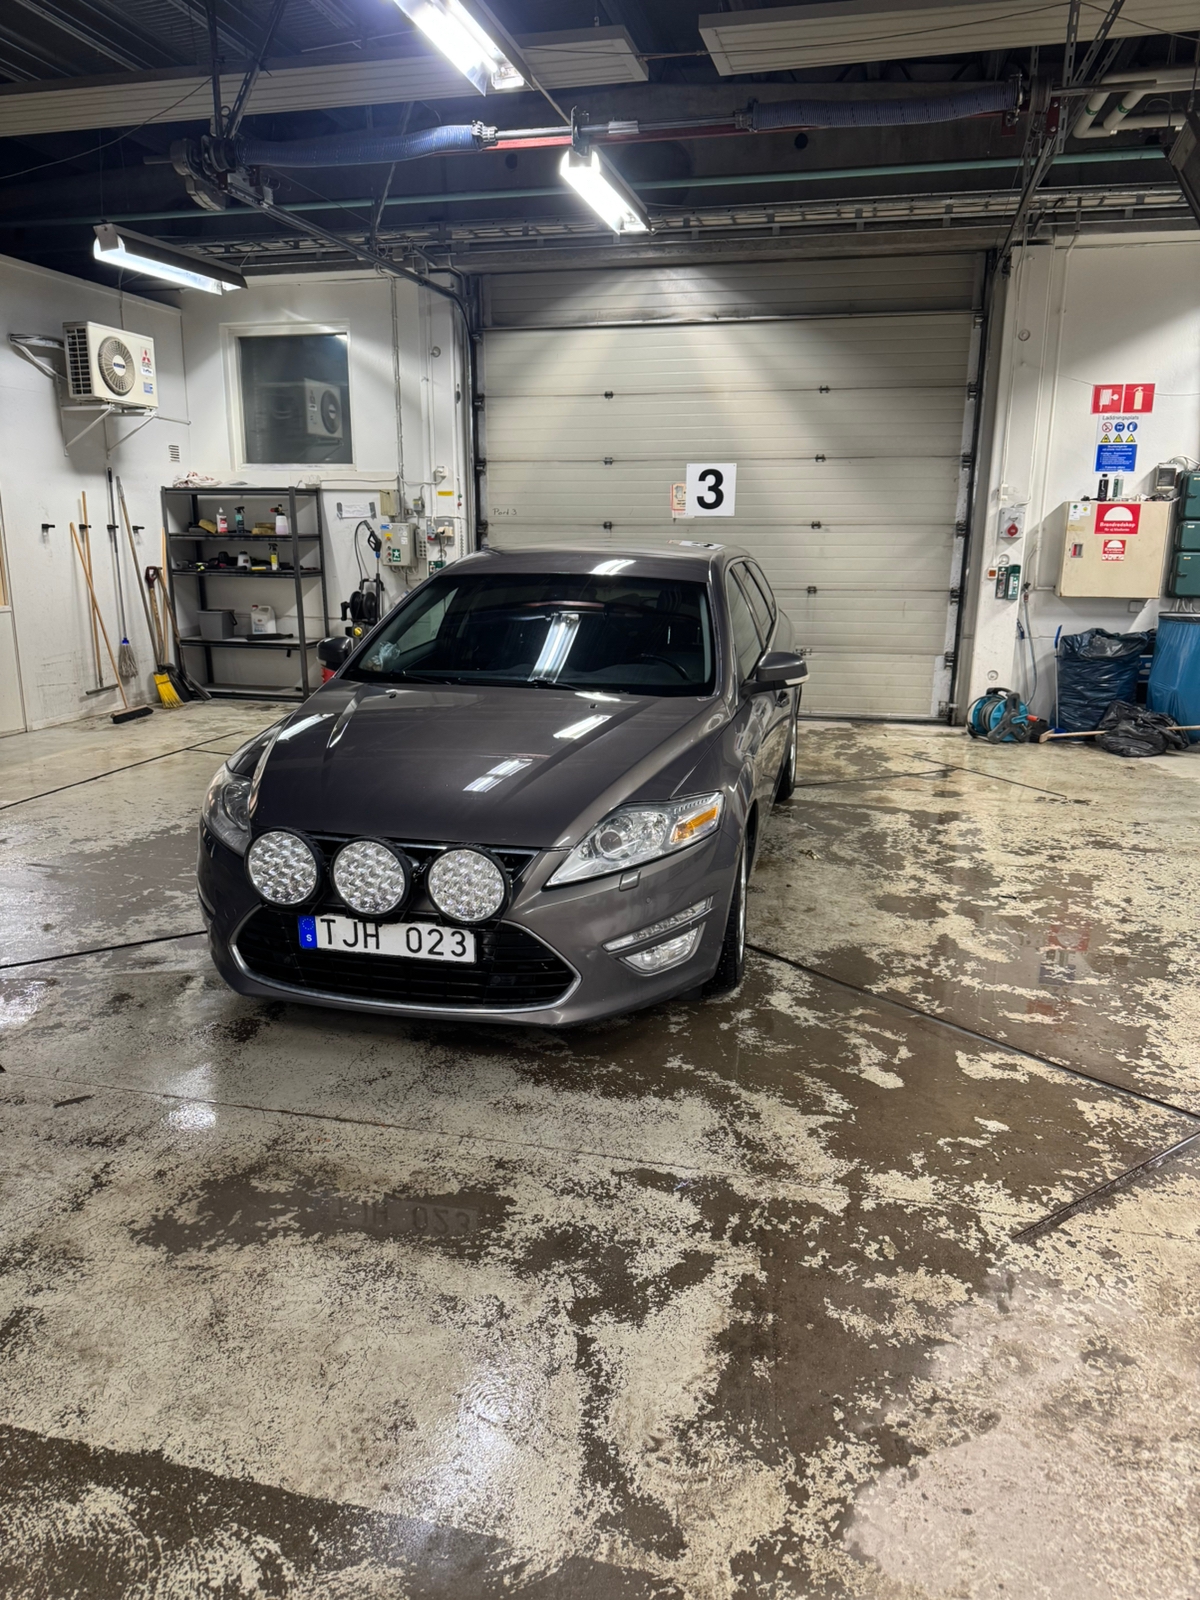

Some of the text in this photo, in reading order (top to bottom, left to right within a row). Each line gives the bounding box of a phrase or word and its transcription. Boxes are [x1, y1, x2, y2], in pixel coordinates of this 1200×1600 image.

[696, 469, 724, 510] 3
[511, 508, 518, 516] 3
[306, 934, 313, 942] S
[320, 918, 467, 957] TJH 023
